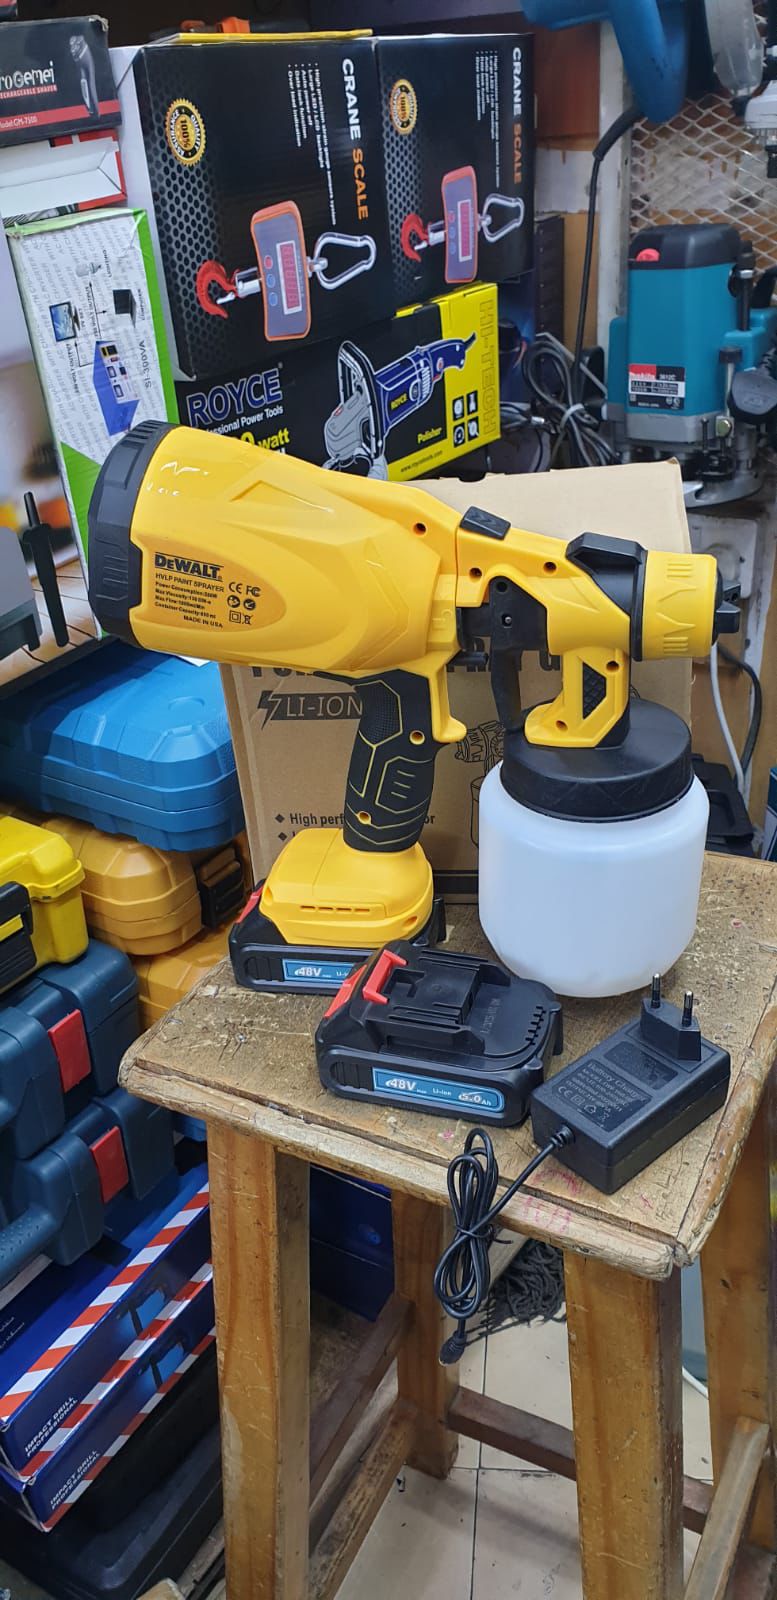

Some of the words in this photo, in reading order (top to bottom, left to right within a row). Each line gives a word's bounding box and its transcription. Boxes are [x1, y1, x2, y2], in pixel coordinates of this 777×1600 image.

[512, 47, 522, 116] CRANE
[303, 90, 311, 114] power
[180, 119, 192, 148] 100%
[342, 58, 361, 140] CRANE
[352, 148, 369, 220] SCALE
[513, 123, 522, 184] SCALE
[138, 340, 152, 390] SI-300VA
[186, 367, 283, 427] ROYCE
[390, 393, 408, 410] ROYCE
[241, 412, 264, 428] Power
[264, 404, 284, 418] Tools
[417, 427, 442, 444] Polisher
[155, 572, 173, 582] HVLP
[174, 576, 193, 586] PAINT
[193, 580, 224, 593] SPRAYER
[183, 615, 202, 624] MADE
[210, 620, 224, 629] USA
[286, 695, 363, 718] LI-ION
[290, 812, 318, 826] High
[320, 812, 345, 828] perf
[294, 966, 322, 977] 48V
[386, 1079, 416, 1090] 48V
[24, 1419, 52, 1452] IMPACT
[53, 1397, 74, 1420] DRILL
[26, 1399, 78, 1457] PROFESSIONAL
[50, 1472, 76, 1504] IMPACT
[77, 1450, 97, 1472] DRILL
[52, 1453, 100, 1510] PROFESSIONAL
